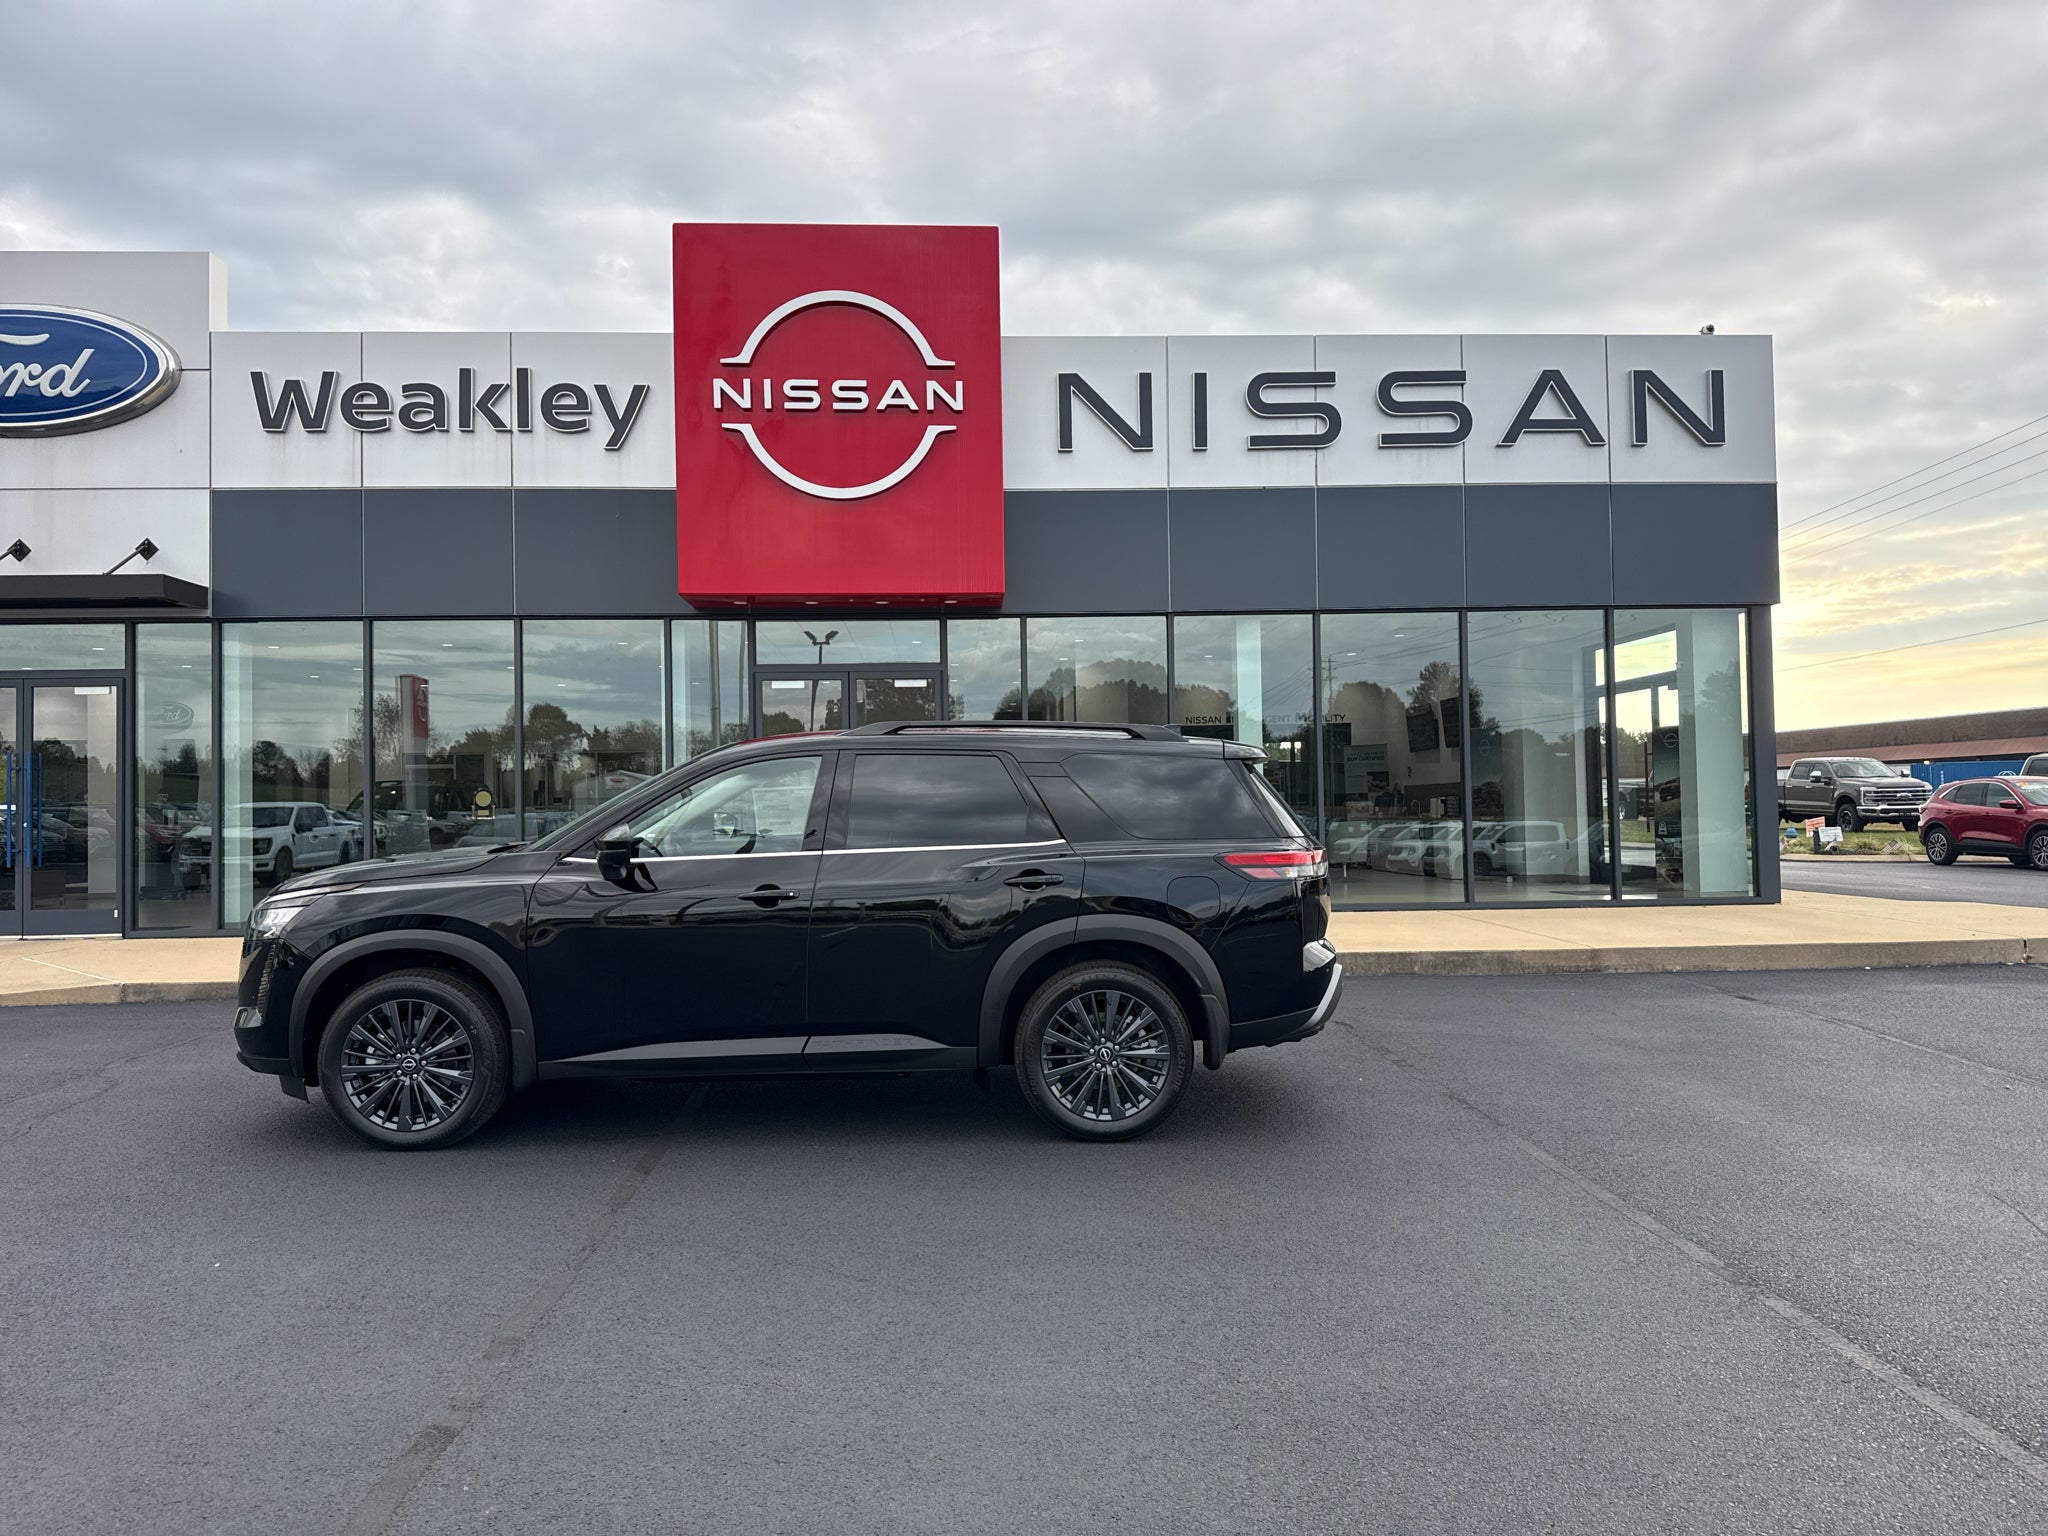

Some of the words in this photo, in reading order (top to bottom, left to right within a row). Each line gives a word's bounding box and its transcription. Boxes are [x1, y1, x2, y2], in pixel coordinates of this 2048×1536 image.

[0, 333, 96, 398] rd
[712, 377, 964, 412] NISSAN
[250, 366, 650, 451] Weakley
[1056, 368, 1726, 453] NISSAN
[1185, 715, 1222, 725] NISSAN
[1294, 711, 1347, 723] MOILITY
[1167, 1017, 1186, 1093] BRIDGESTONE
